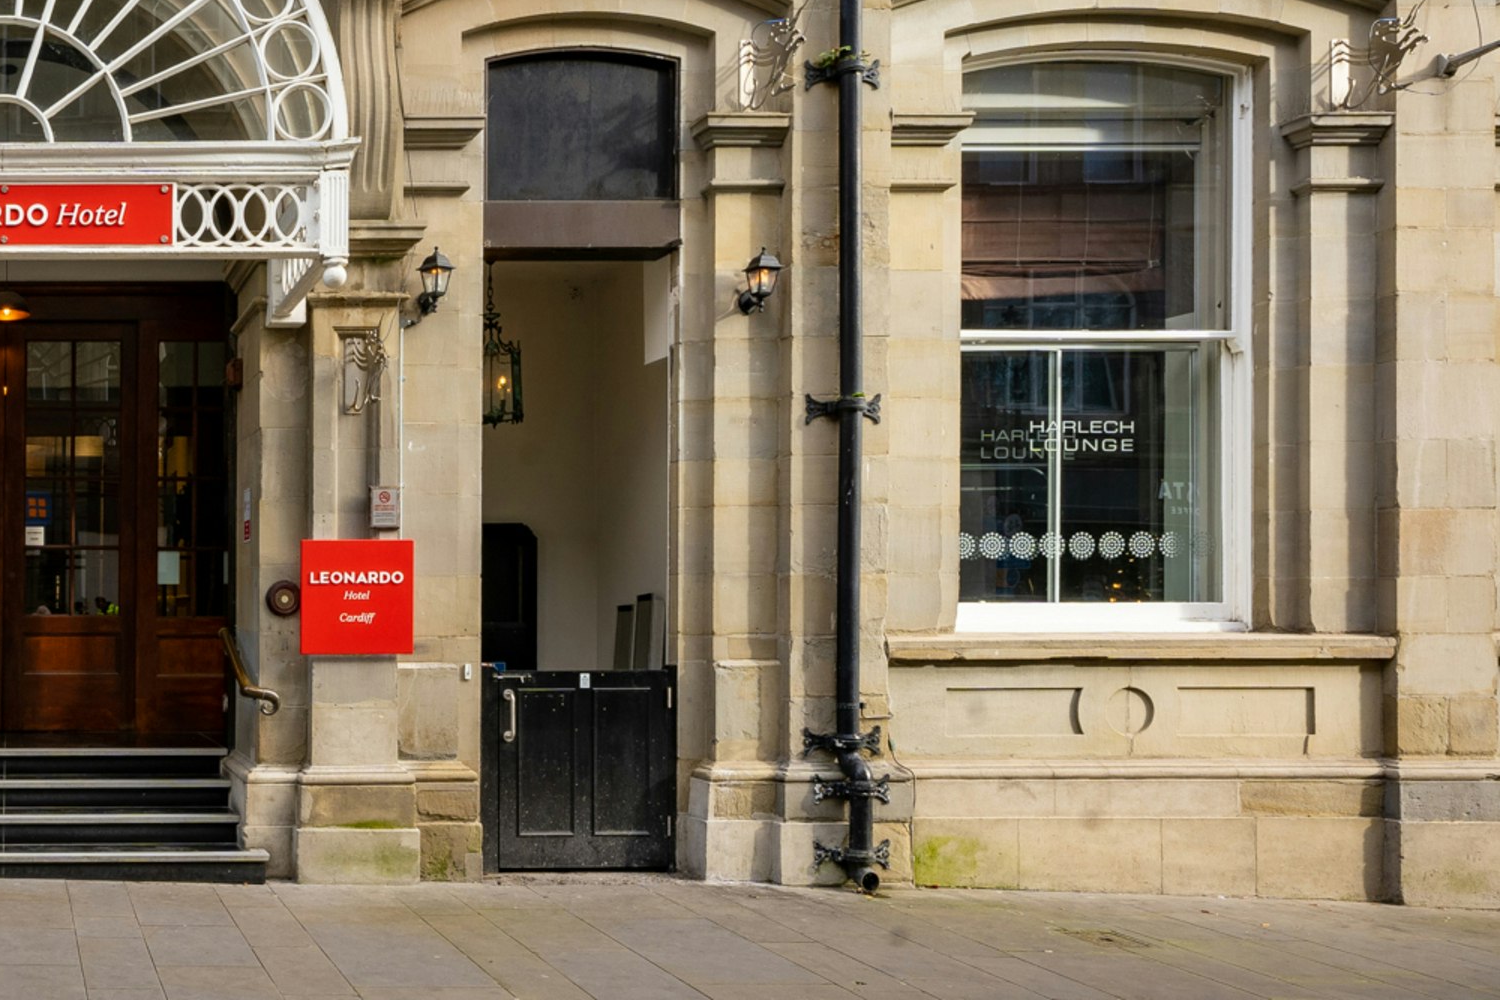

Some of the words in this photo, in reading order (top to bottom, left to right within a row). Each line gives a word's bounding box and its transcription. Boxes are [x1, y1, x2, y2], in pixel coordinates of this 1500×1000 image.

[55, 202, 127, 226] Hotel
[1029, 420, 1135, 434] HARLECH
[1029, 439, 1134, 452] LOUNGE
[309, 571, 405, 584] LEONARDO
[343, 590, 370, 600] Hotel
[339, 612, 376, 624] Cardiff
